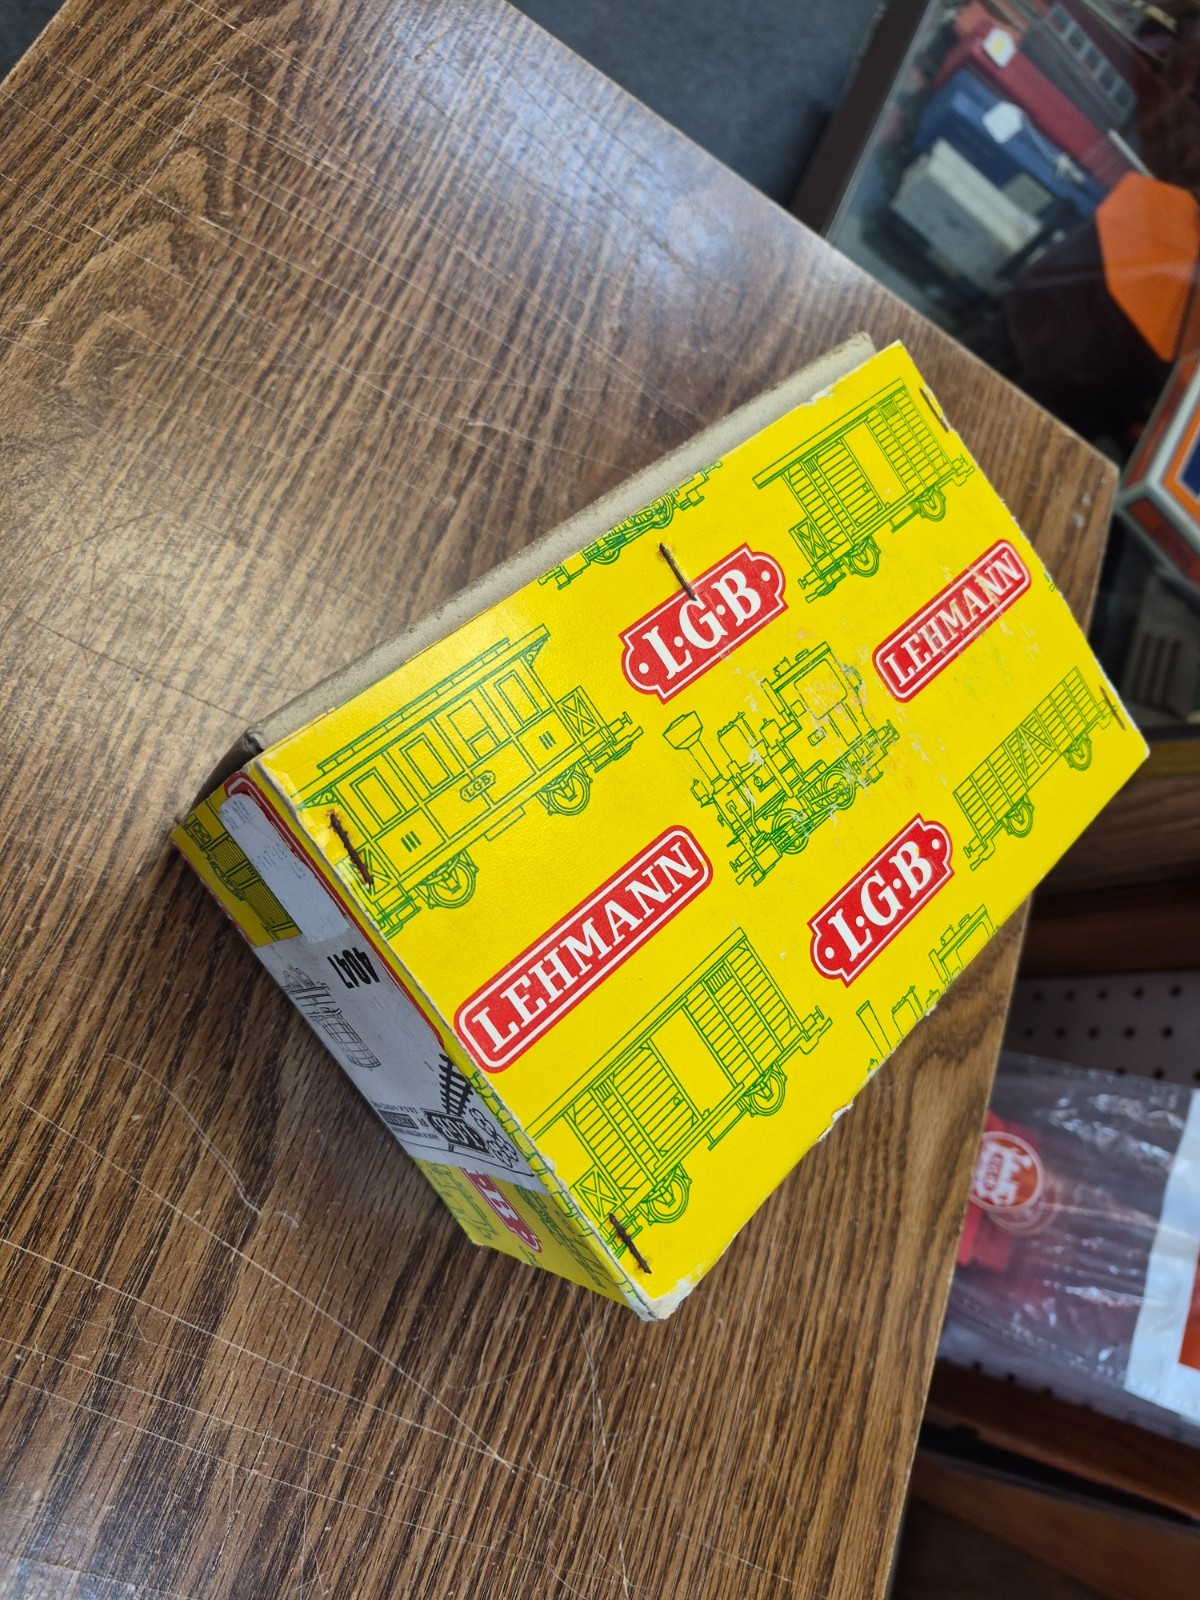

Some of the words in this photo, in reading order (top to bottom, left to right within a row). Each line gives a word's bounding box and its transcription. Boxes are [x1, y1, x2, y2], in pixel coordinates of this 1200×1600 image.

[884, 553, 1023, 686] LEHMANN
[327, 947, 380, 989] 4047
[472, 842, 698, 1052] LEHMANN
